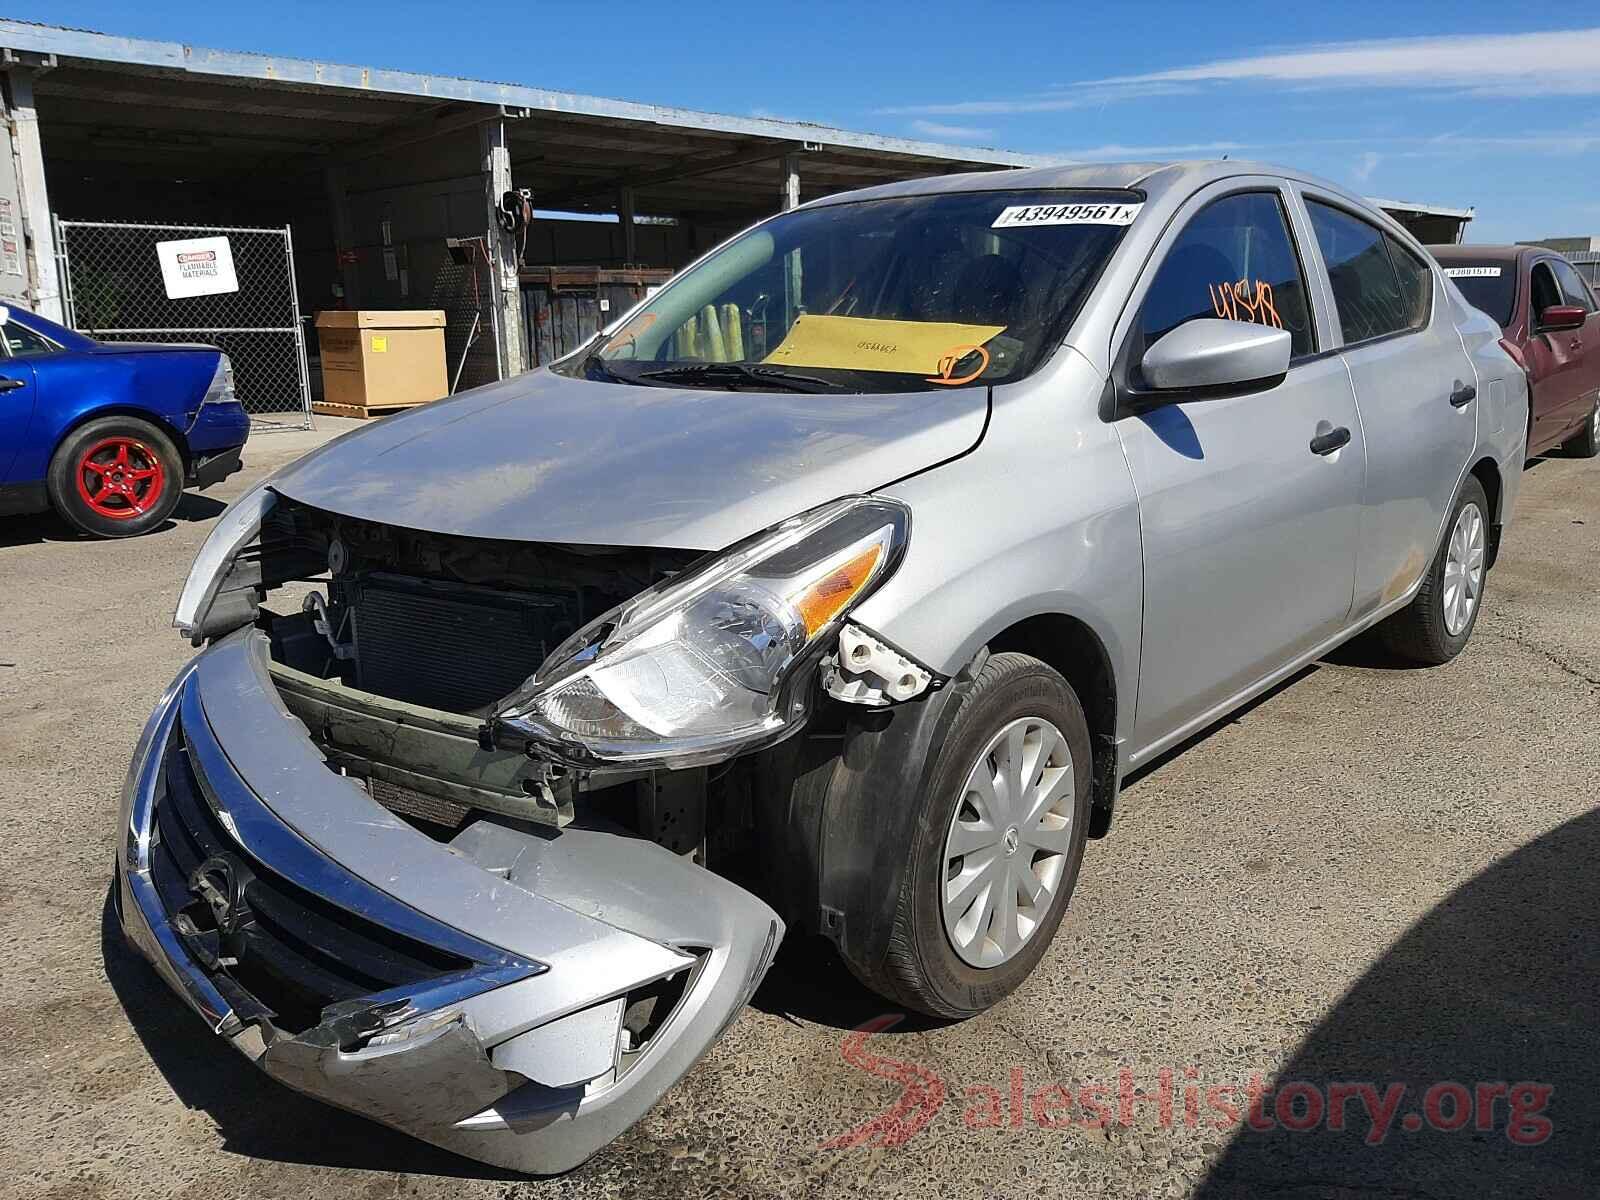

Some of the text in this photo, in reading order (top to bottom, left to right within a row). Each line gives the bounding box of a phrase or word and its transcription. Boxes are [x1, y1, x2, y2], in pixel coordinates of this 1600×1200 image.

[1014, 205, 1122, 222] 43949561
[179, 262, 217, 271] FLAMMABLE
[182, 269, 218, 278] MATERIALS
